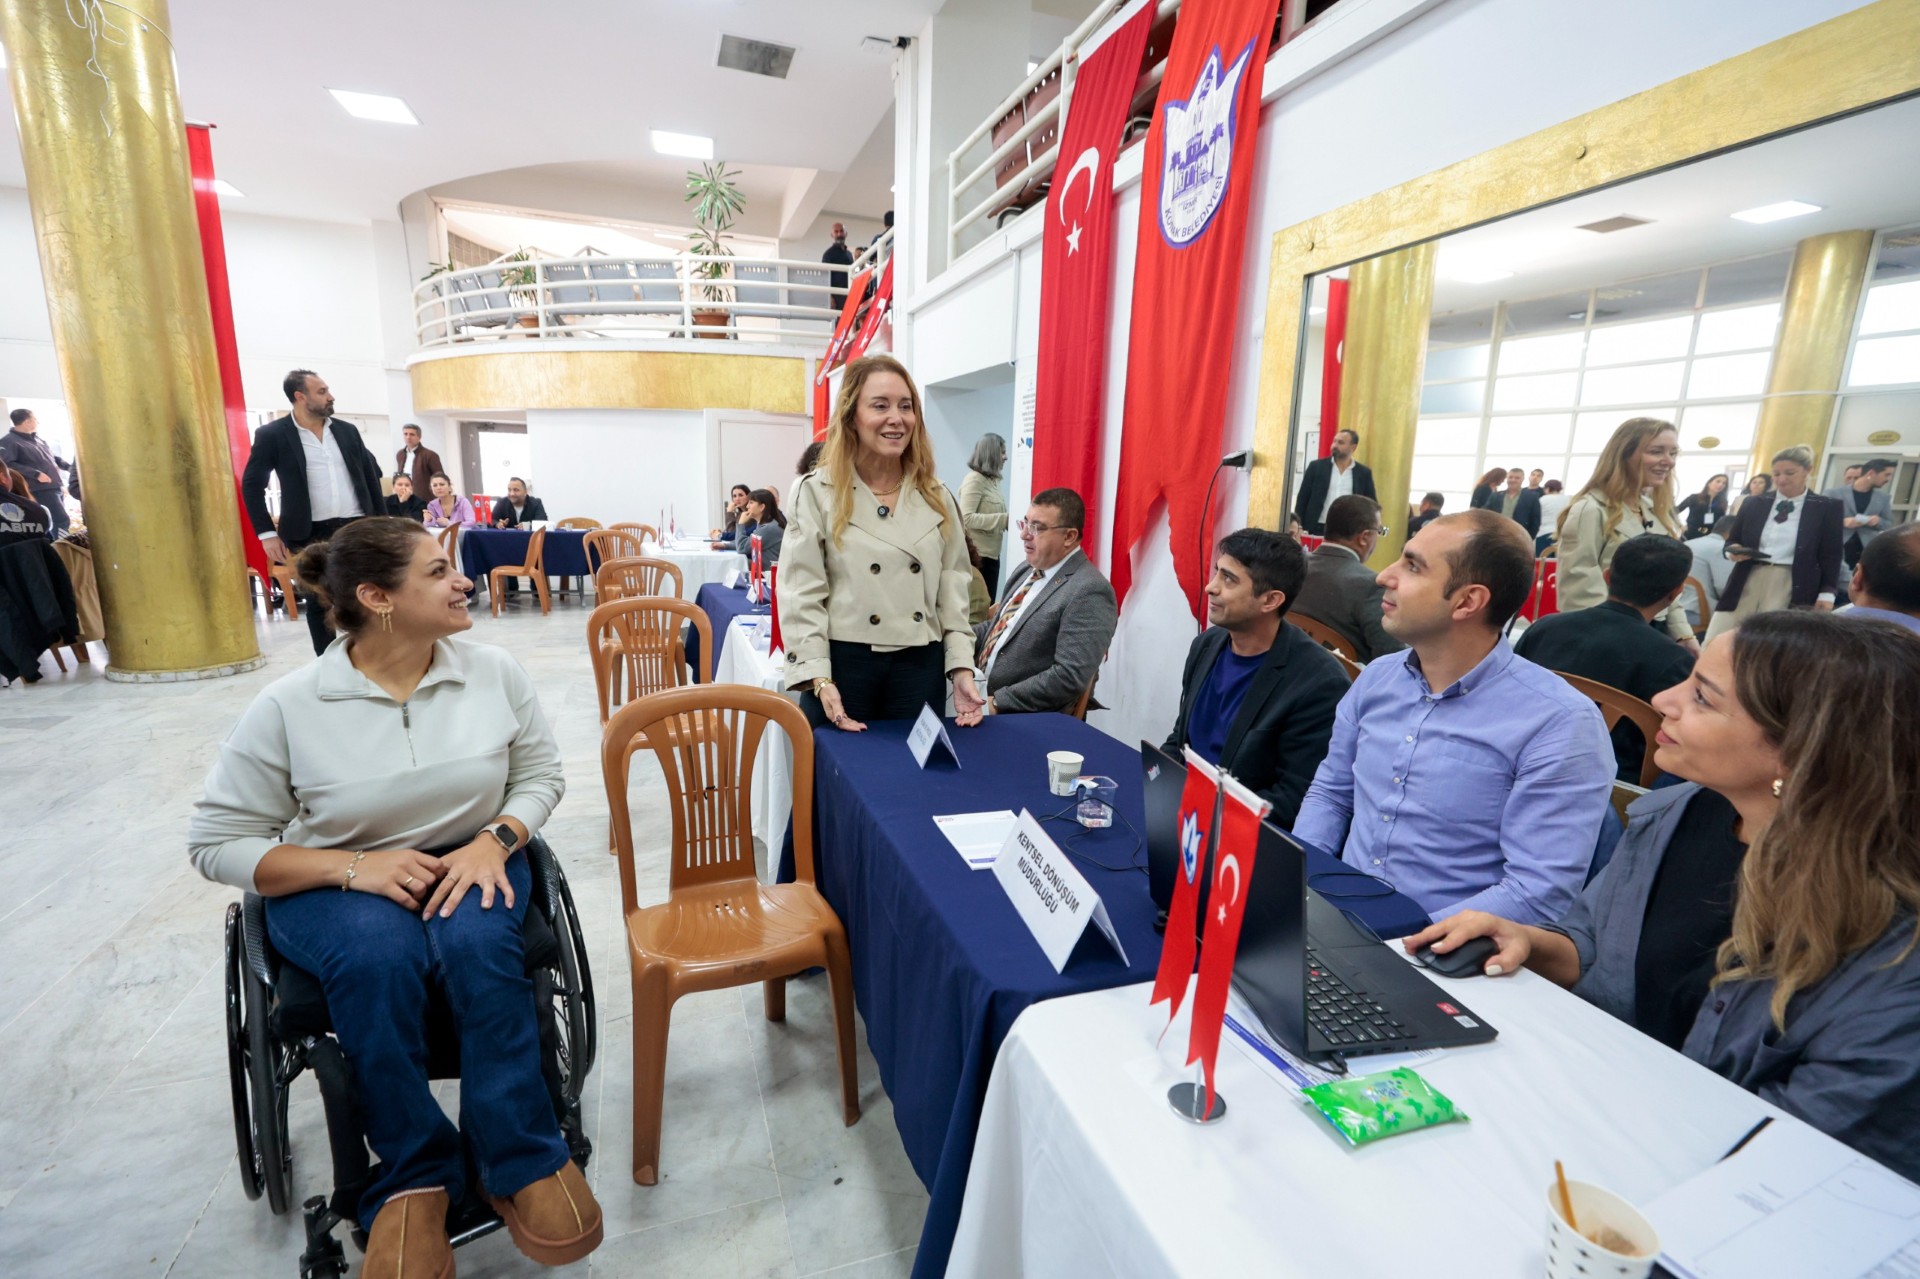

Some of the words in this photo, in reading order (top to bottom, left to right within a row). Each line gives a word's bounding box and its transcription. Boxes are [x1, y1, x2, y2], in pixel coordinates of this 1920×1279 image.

[1017, 831, 1044, 869] KENTSEL
[1042, 862, 1080, 914] DÖNÜŞÜM
[1017, 856, 1059, 914] MÜDÜRLÜĞÜ
